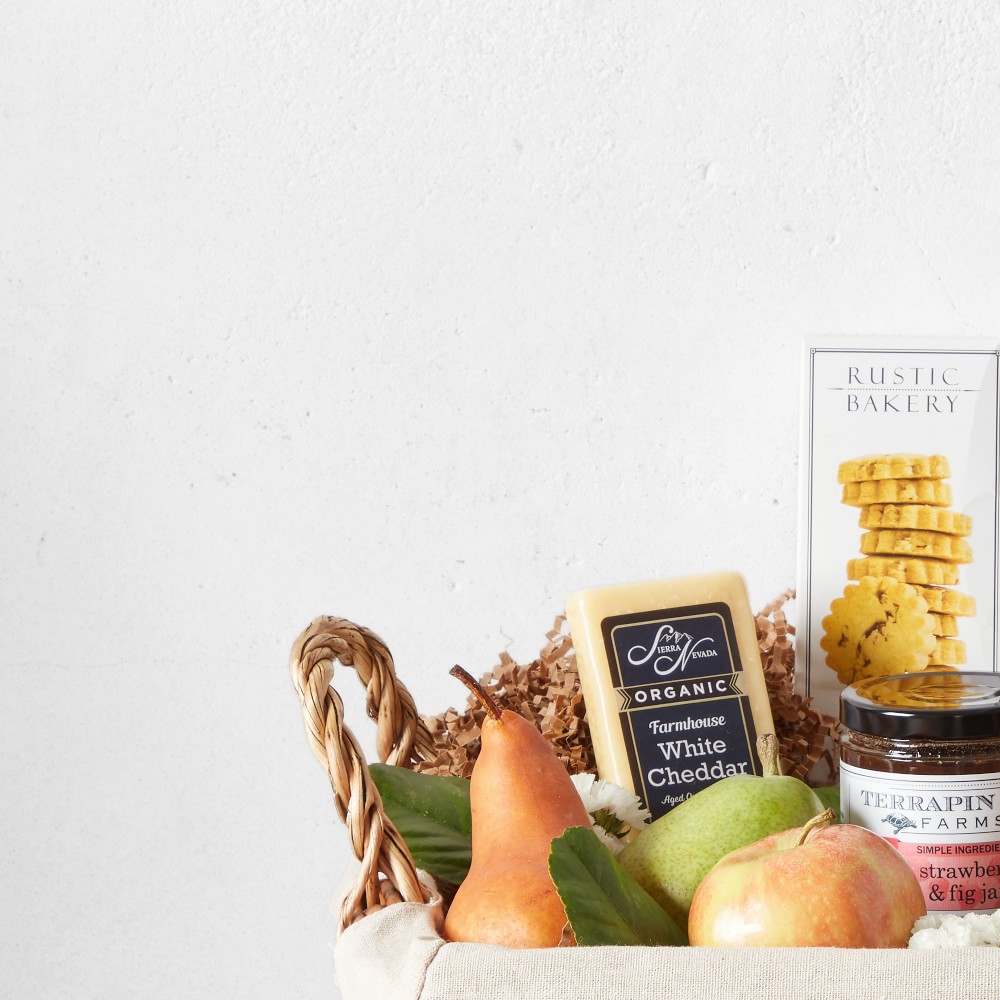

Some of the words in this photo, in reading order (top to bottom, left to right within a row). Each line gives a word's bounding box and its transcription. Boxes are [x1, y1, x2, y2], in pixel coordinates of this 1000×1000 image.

[848, 366, 960, 386] RUSTIC
[847, 394, 960, 413] BAKERY
[628, 625, 681, 665] SIERRA
[654, 637, 718, 676] NEVADA
[634, 679, 728, 703] ORGANIC
[648, 714, 726, 735] Farmhouse
[657, 738, 727, 761] White
[647, 760, 748, 787] Cheddar
[661, 793, 685, 806] Aged
[861, 789, 996, 812] TERRAPIN
[916, 845, 952, 855] SIMPLE
[929, 885, 945, 901] &
[948, 884, 976, 904] fig
